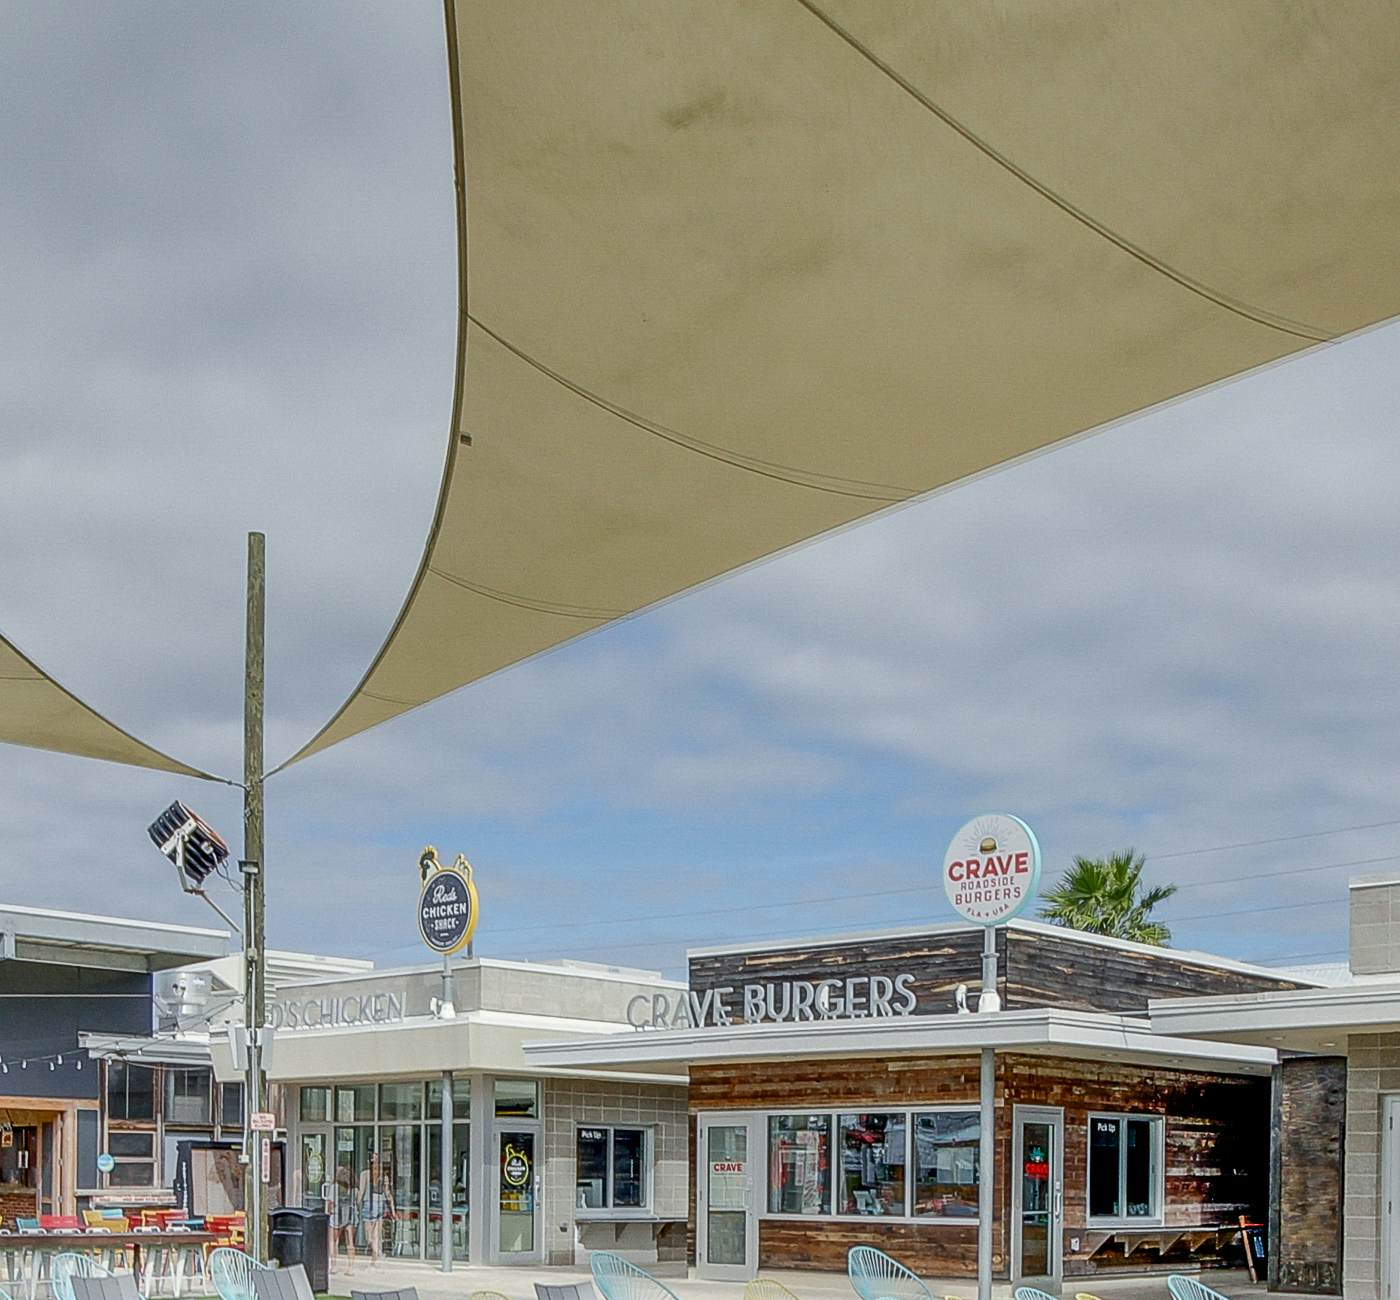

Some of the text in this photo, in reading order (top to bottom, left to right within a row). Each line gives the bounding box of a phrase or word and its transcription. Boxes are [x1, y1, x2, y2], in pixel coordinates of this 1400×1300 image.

[948, 852, 1029, 882] CRAVE
[960, 876, 1015, 891] ROADSIDE
[955, 886, 1021, 905] BURGERS
[422, 902, 467, 919] CHICKEN
[992, 903, 1009, 916] USA
[434, 917, 456, 931] SHACK
[302, 991, 407, 1027] CHICKEN
[627, 974, 916, 1028] CRAVE BURGERS
[713, 1163, 743, 1172] CRAVE
